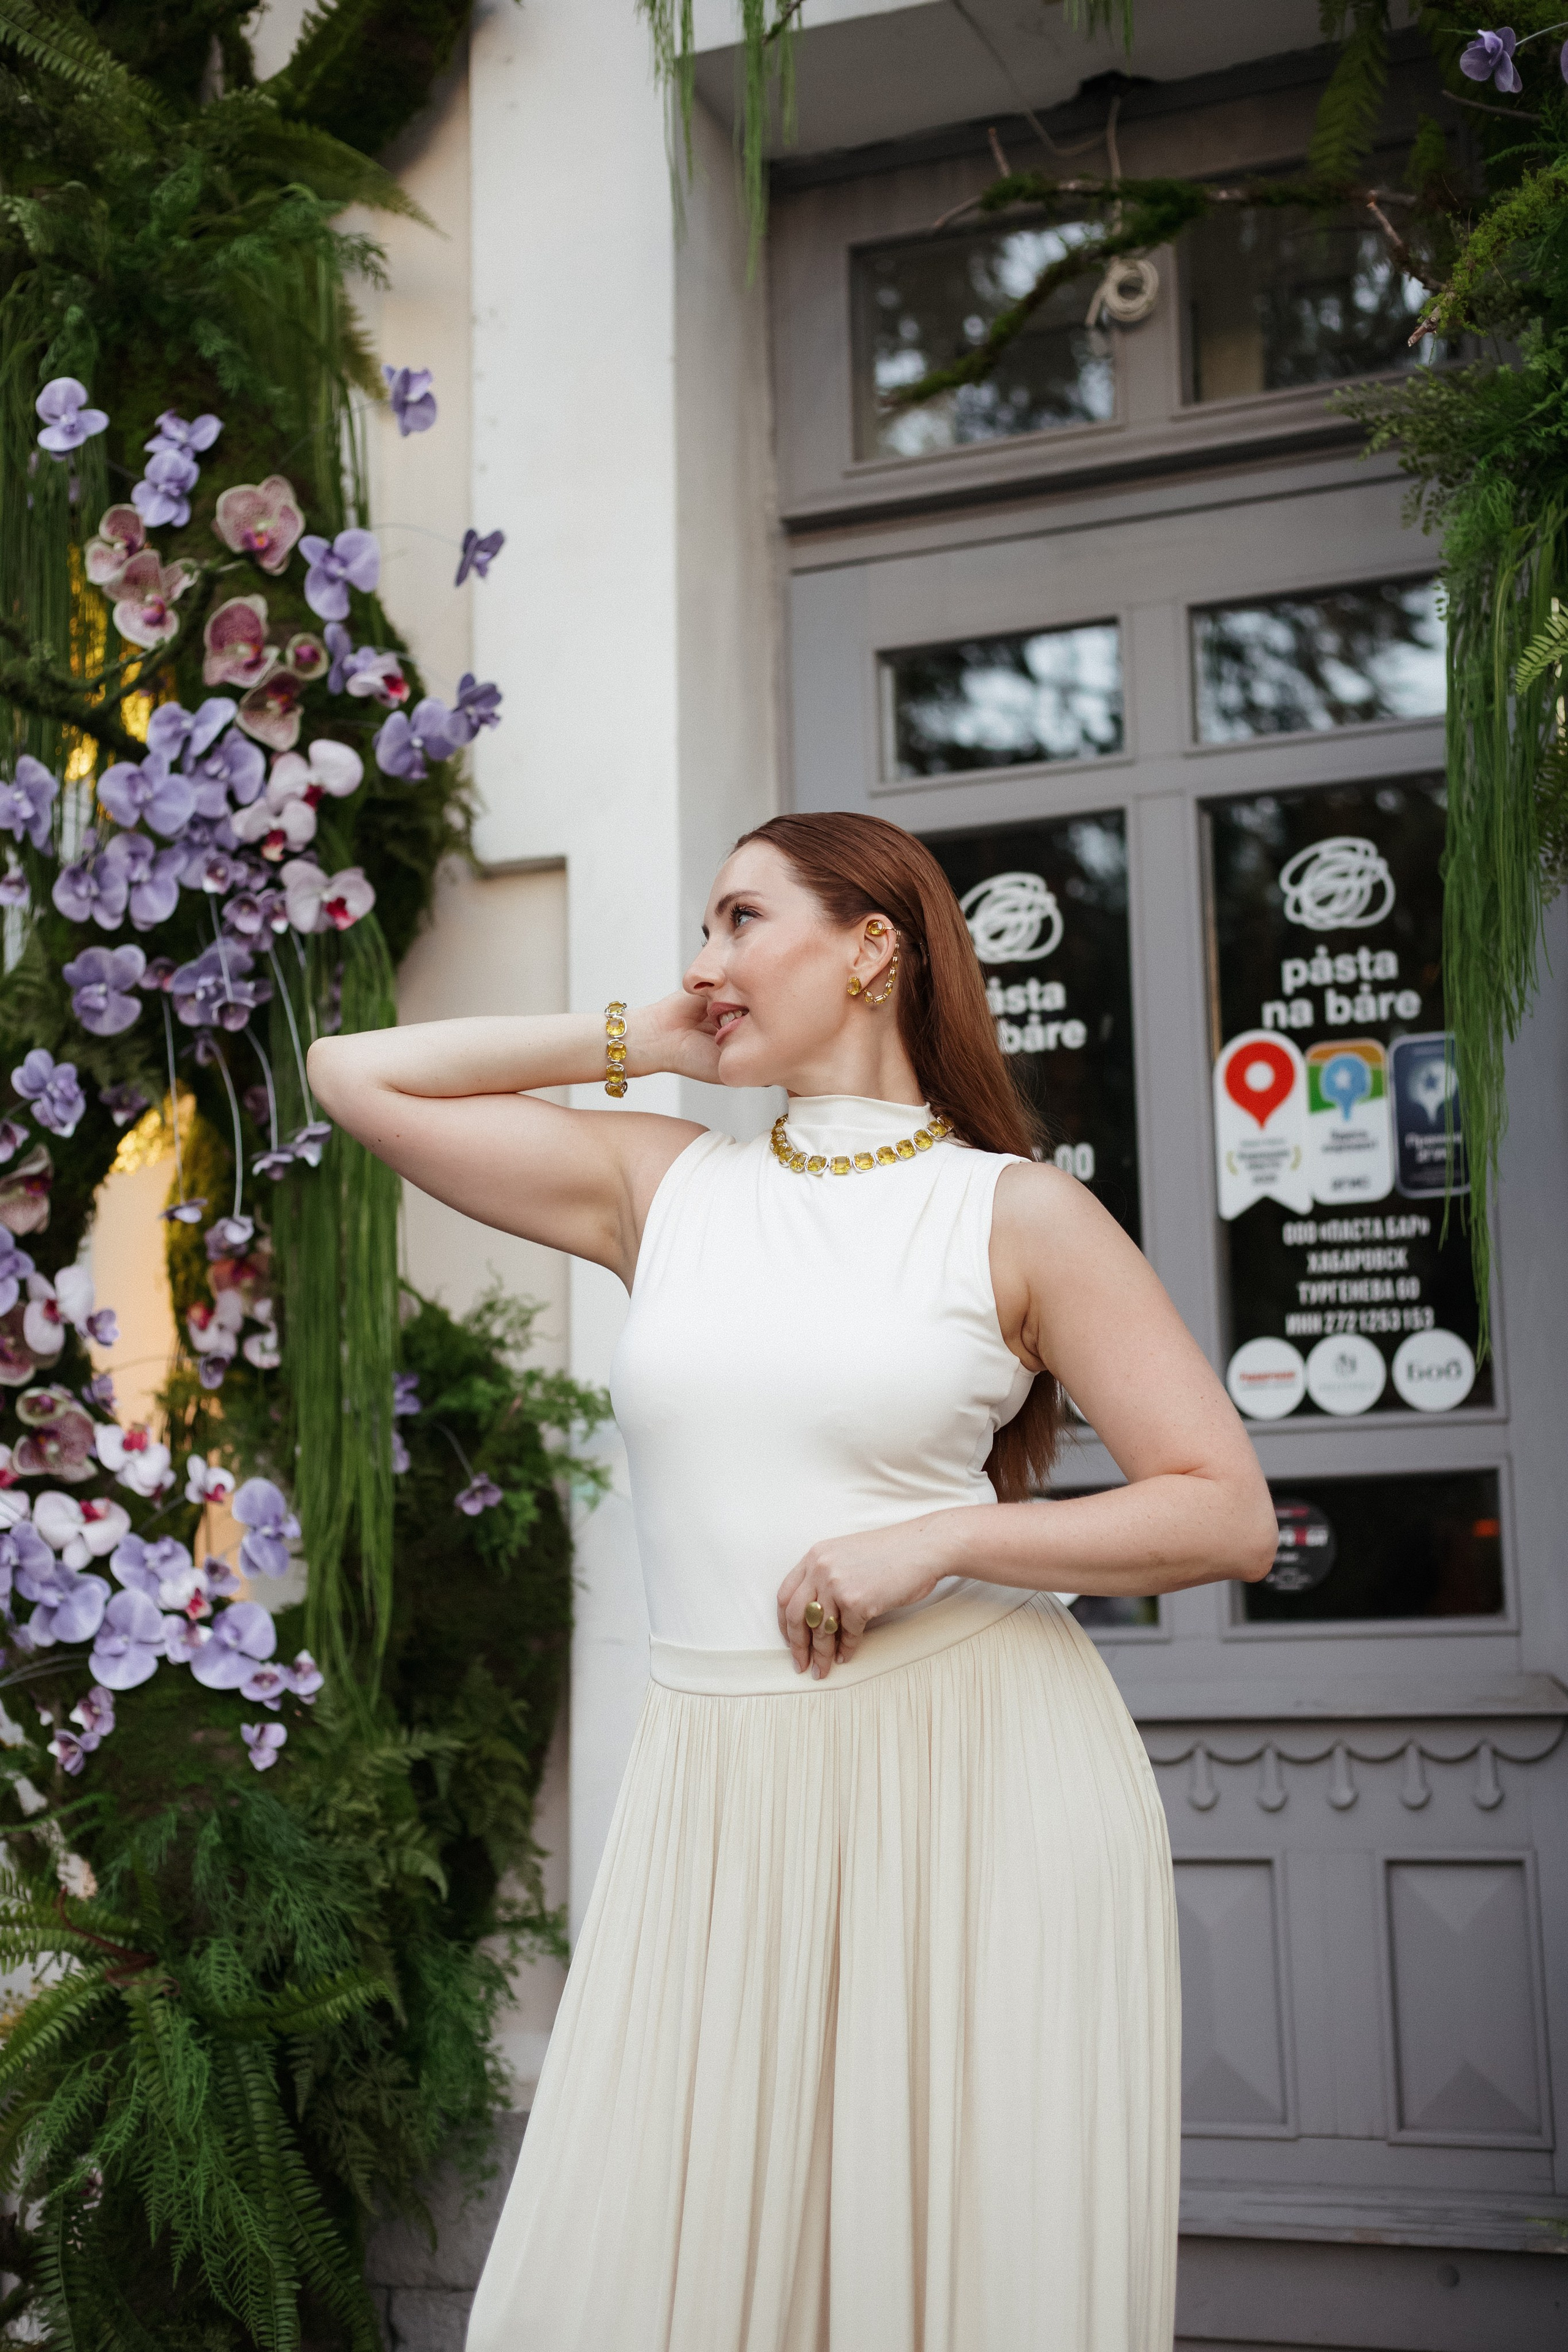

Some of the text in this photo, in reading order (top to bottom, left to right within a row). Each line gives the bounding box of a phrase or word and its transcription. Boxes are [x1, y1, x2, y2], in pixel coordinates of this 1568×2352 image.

[1261, 998, 1314, 1029] na
[1283, 1220, 1317, 1246] ООО
[1306, 1245, 1409, 1275] ХАБАРОВСК
[1296, 1277, 1395, 1306] ТУРГЕНЕВА
